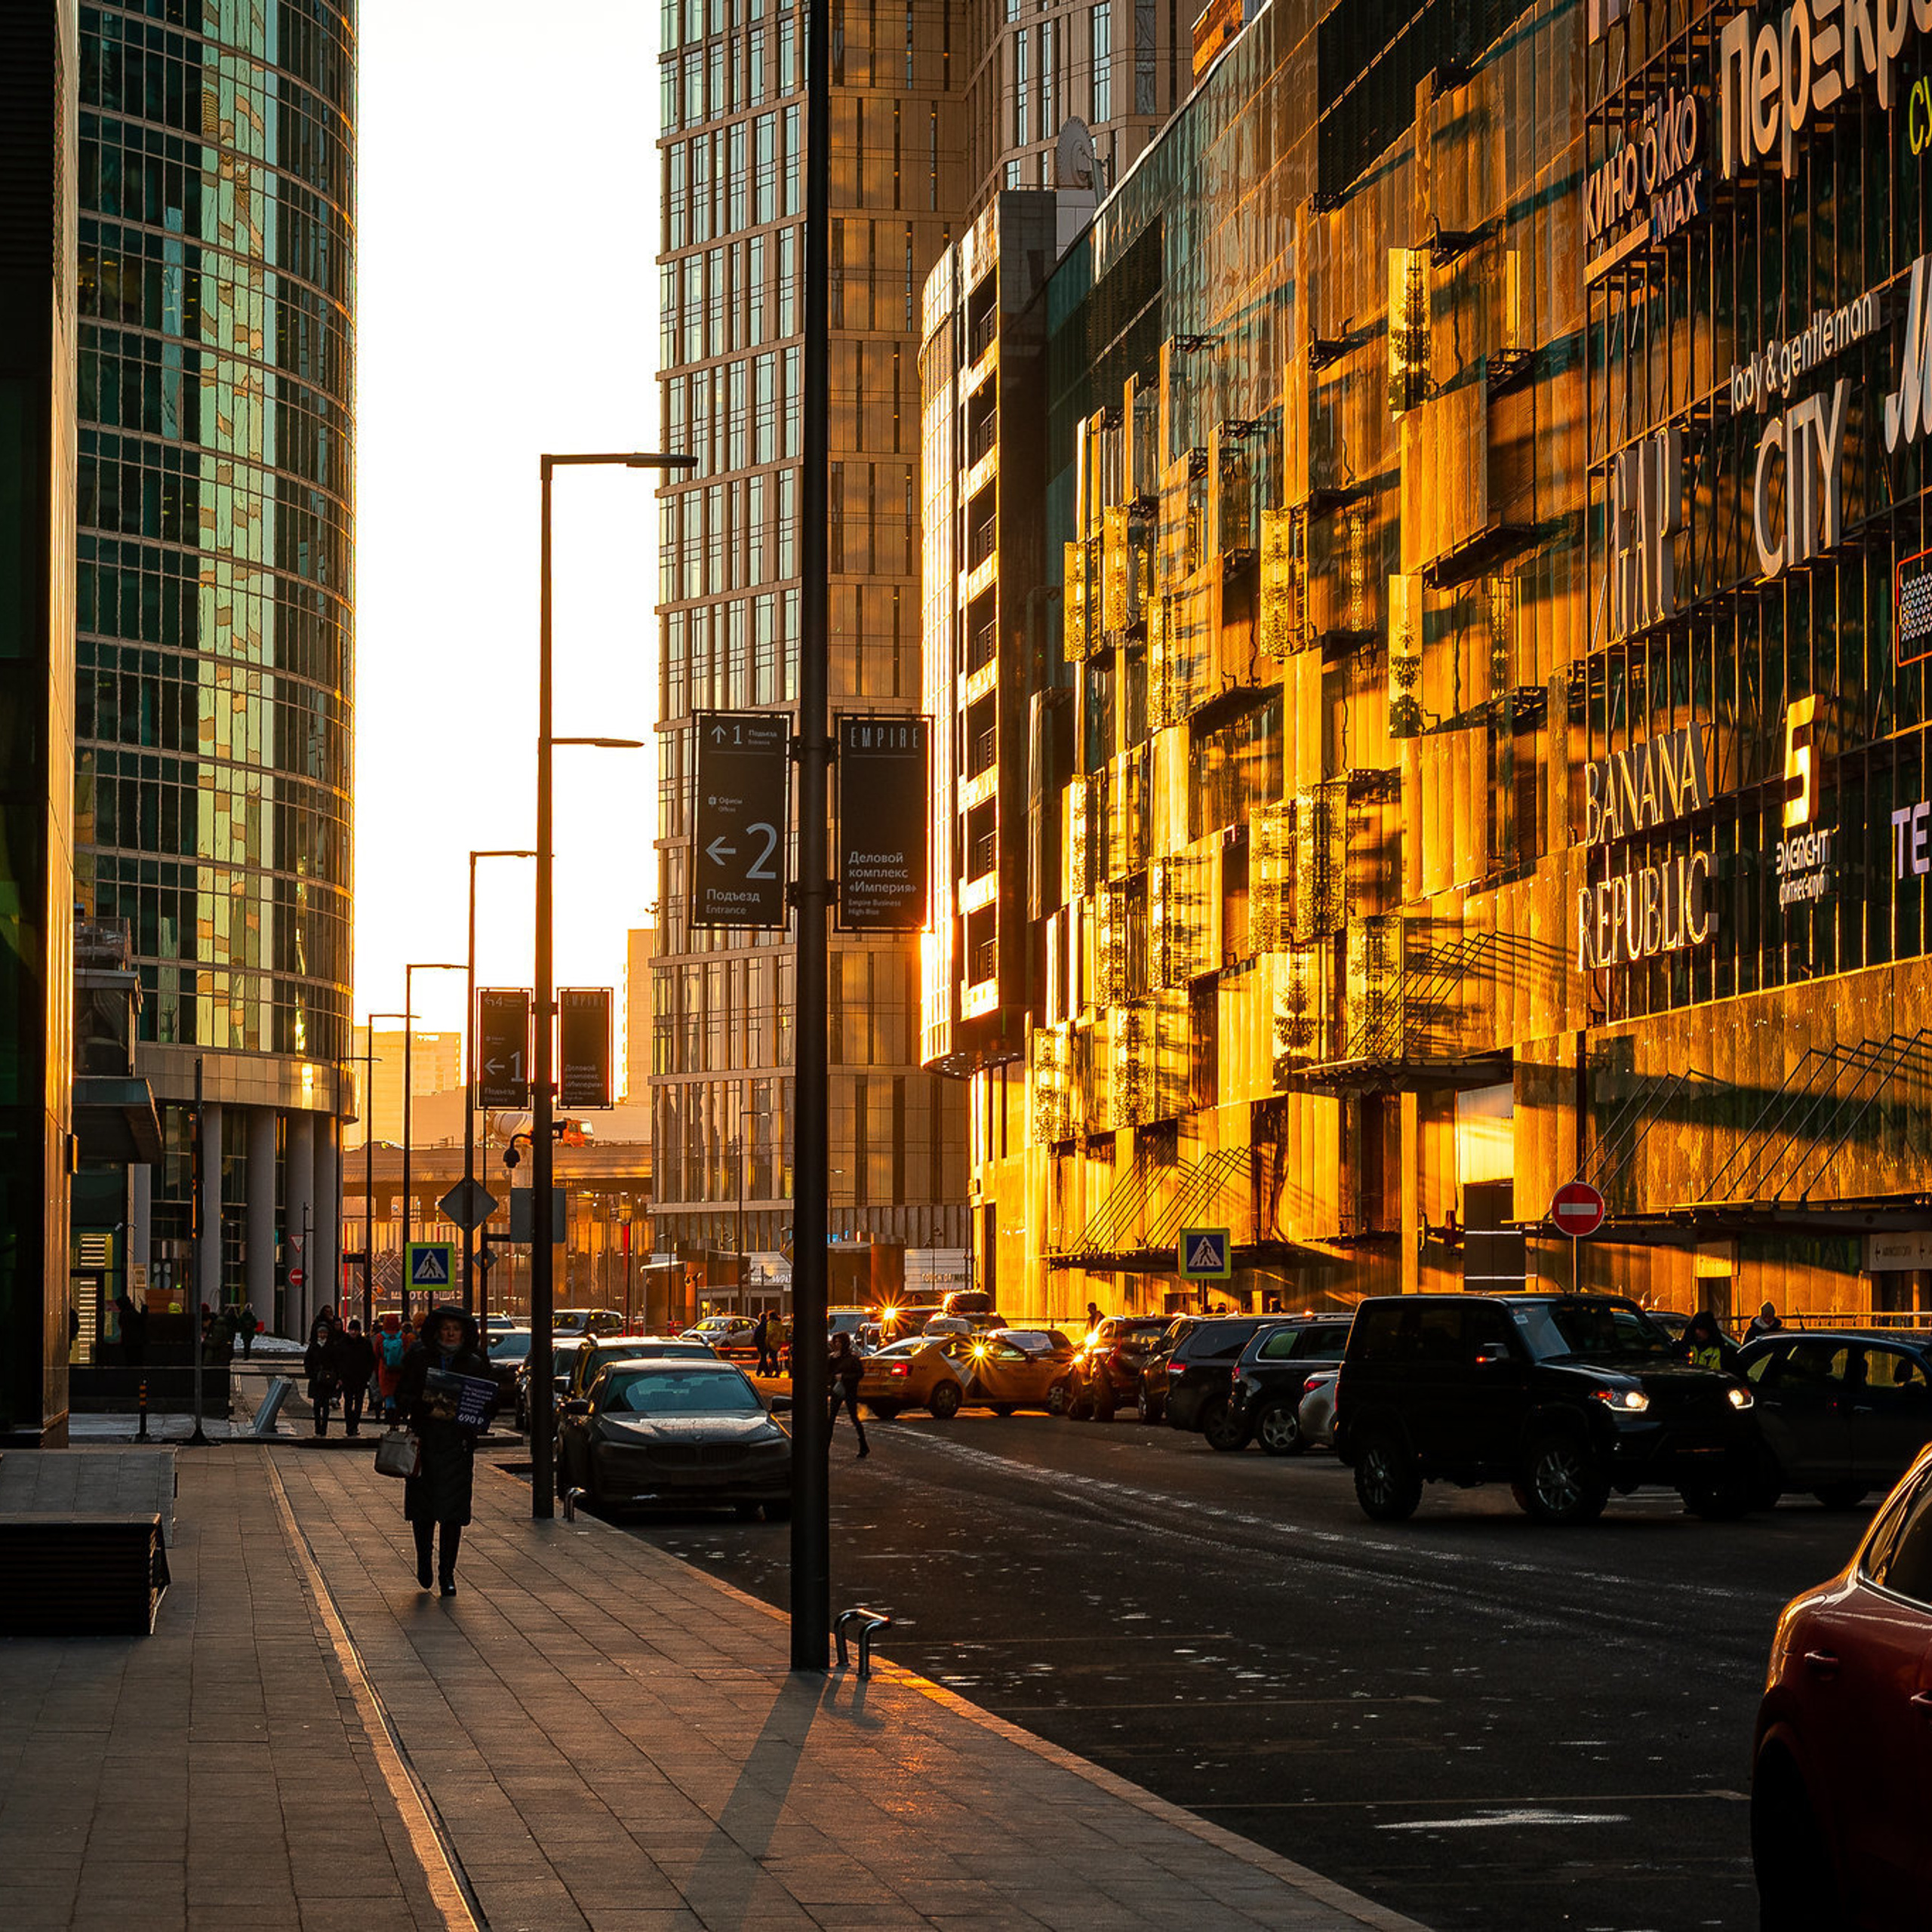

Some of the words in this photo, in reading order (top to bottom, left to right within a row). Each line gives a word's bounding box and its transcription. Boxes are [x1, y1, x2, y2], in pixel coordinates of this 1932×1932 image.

[1730, 351, 1764, 415] lady
[1766, 340, 1778, 392] &
[1780, 292, 1873, 398] gentleman
[1754, 378, 1847, 578] CITY
[1614, 426, 1675, 641] GAP
[733, 724, 743, 744] 1
[851, 727, 918, 748] EMPIRE
[1584, 721, 1703, 848] BANANA
[746, 822, 777, 880] 2
[848, 851, 903, 865] Деловой
[849, 869, 909, 878] комплекс
[706, 888, 761, 903] Подъезд
[849, 881, 917, 895] «Империя»
[706, 904, 747, 915] Entrance
[1577, 851, 1712, 971] REPUBLIC
[510, 1051, 525, 1082] 1
[457, 1413, 477, 1424] 690
